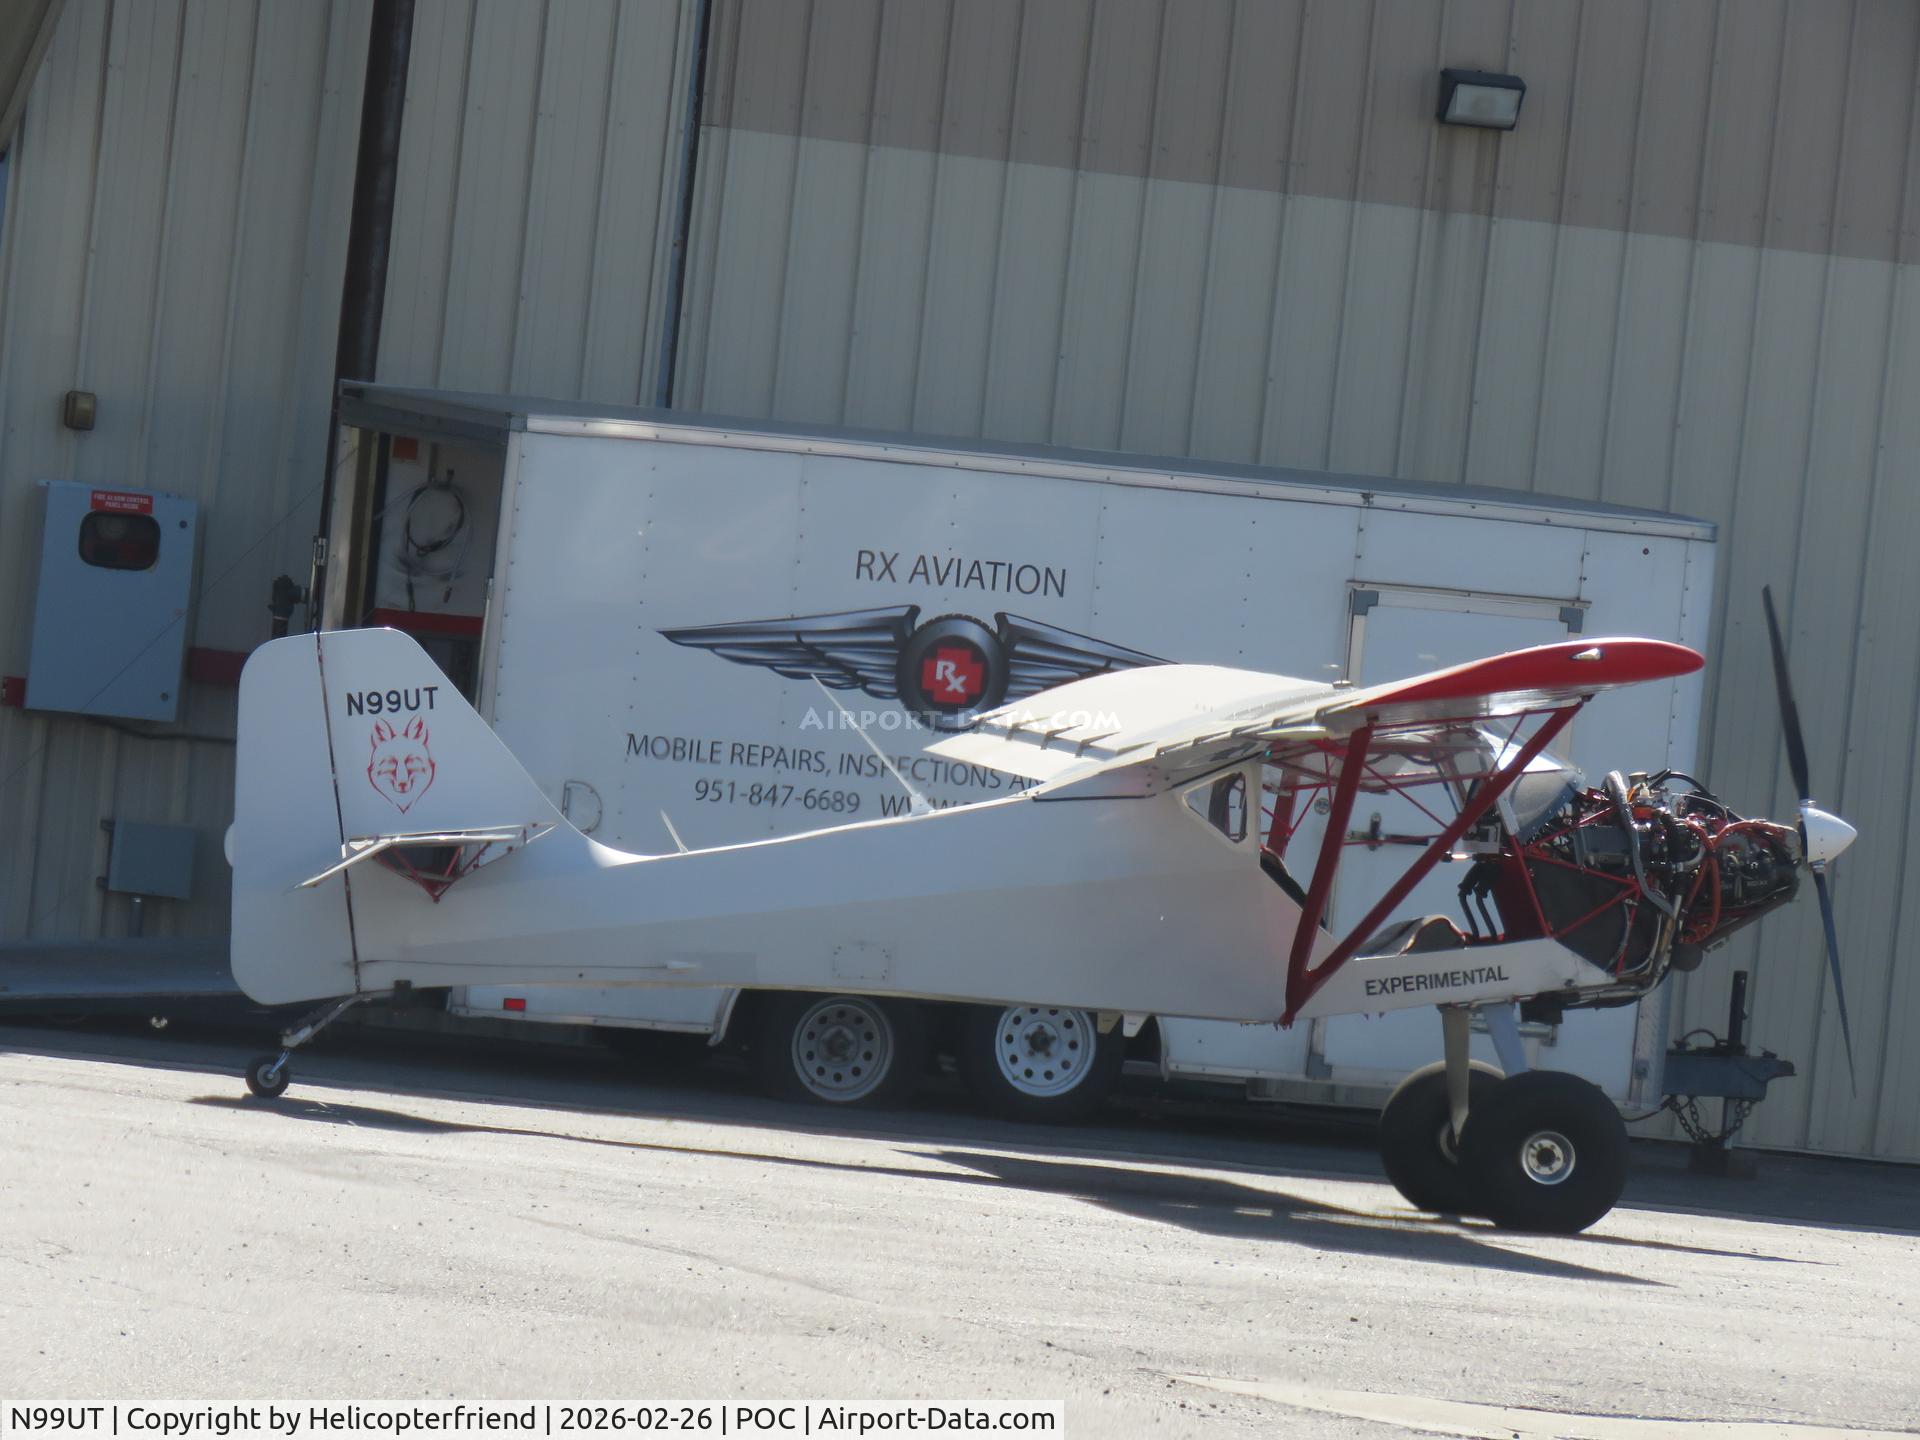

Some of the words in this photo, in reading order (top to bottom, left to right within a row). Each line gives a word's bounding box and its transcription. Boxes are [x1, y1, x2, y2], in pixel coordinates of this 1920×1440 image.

[856, 549, 899, 583] RX
[908, 554, 1066, 598] AVIATION
[346, 686, 438, 716] N99UT
[626, 733, 722, 764] MOBILE
[729, 743, 831, 777] REPAIRS,
[838, 753, 1001, 789] INSPECTIONS
[695, 778, 860, 813] 951-847-6689
[1365, 965, 1509, 996] EXPERIMENTAL
